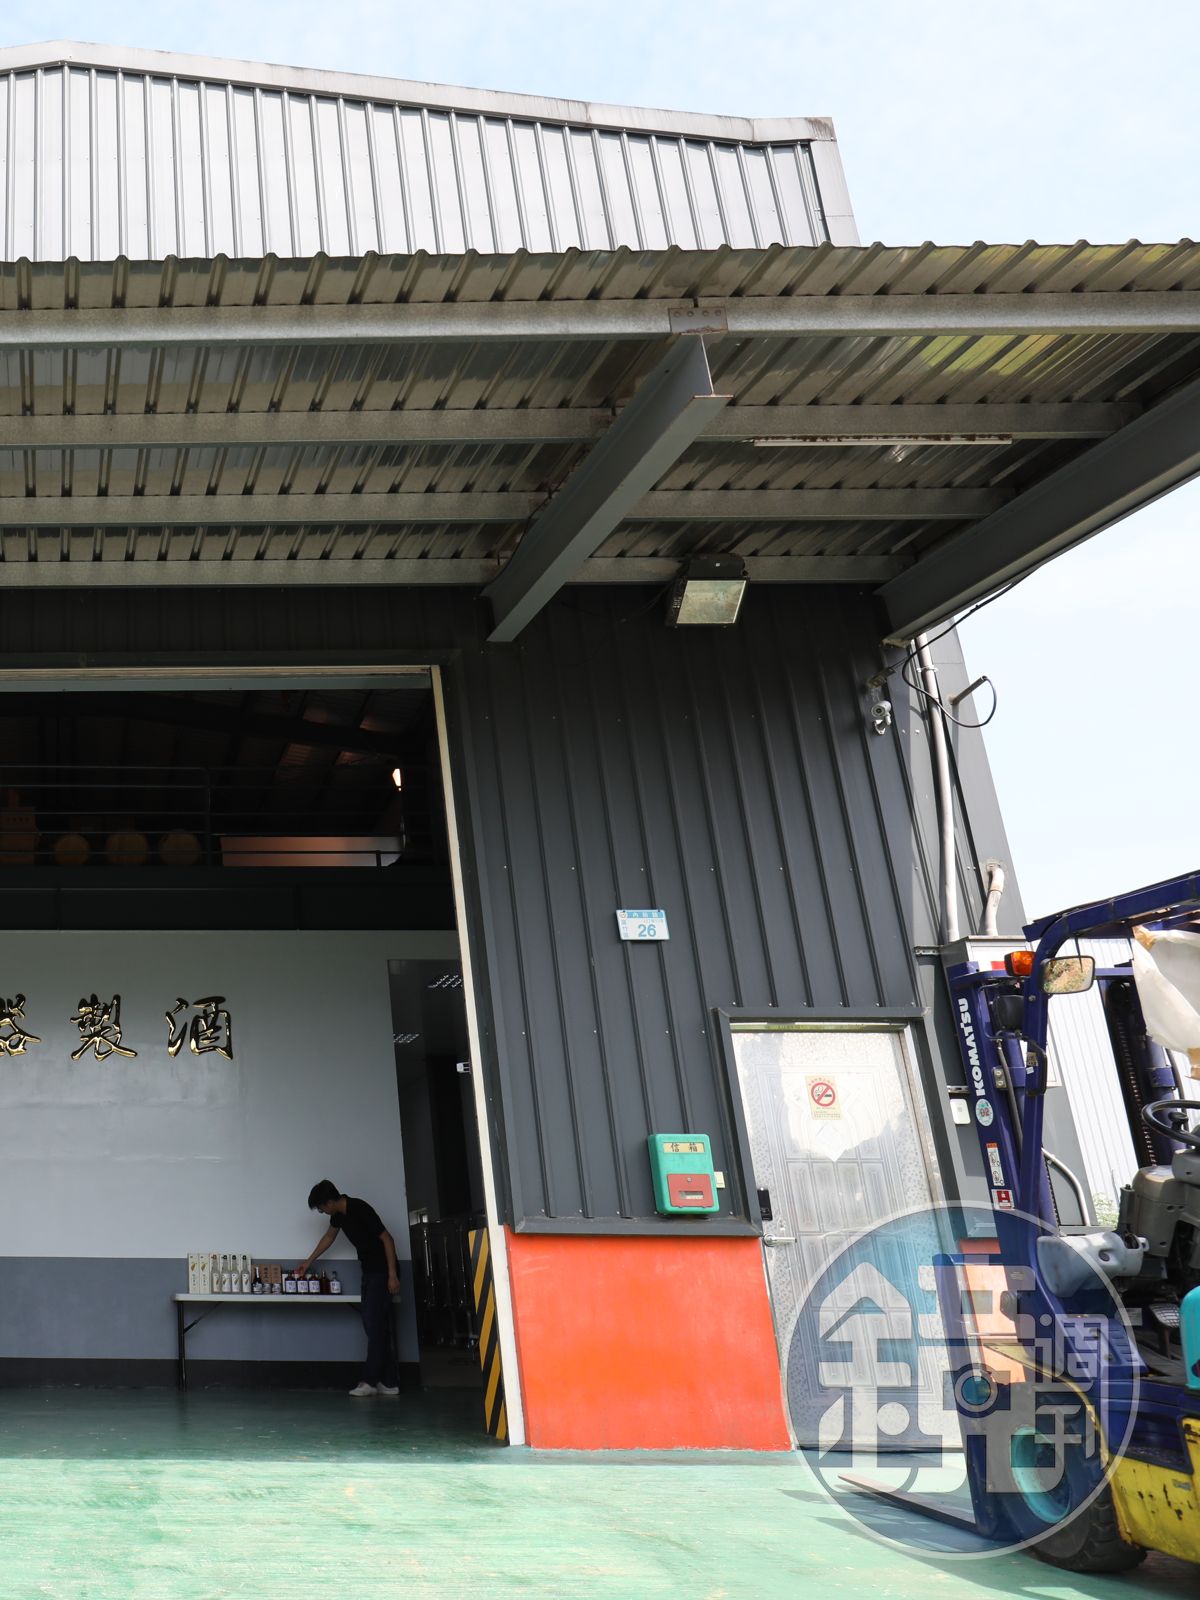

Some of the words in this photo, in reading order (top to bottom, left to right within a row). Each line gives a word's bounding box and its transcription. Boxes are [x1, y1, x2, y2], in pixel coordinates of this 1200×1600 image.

[638, 924, 657, 937] 26
[958, 998, 986, 1096] KOMATSU
[669, 1142, 698, 1153] 信箱
